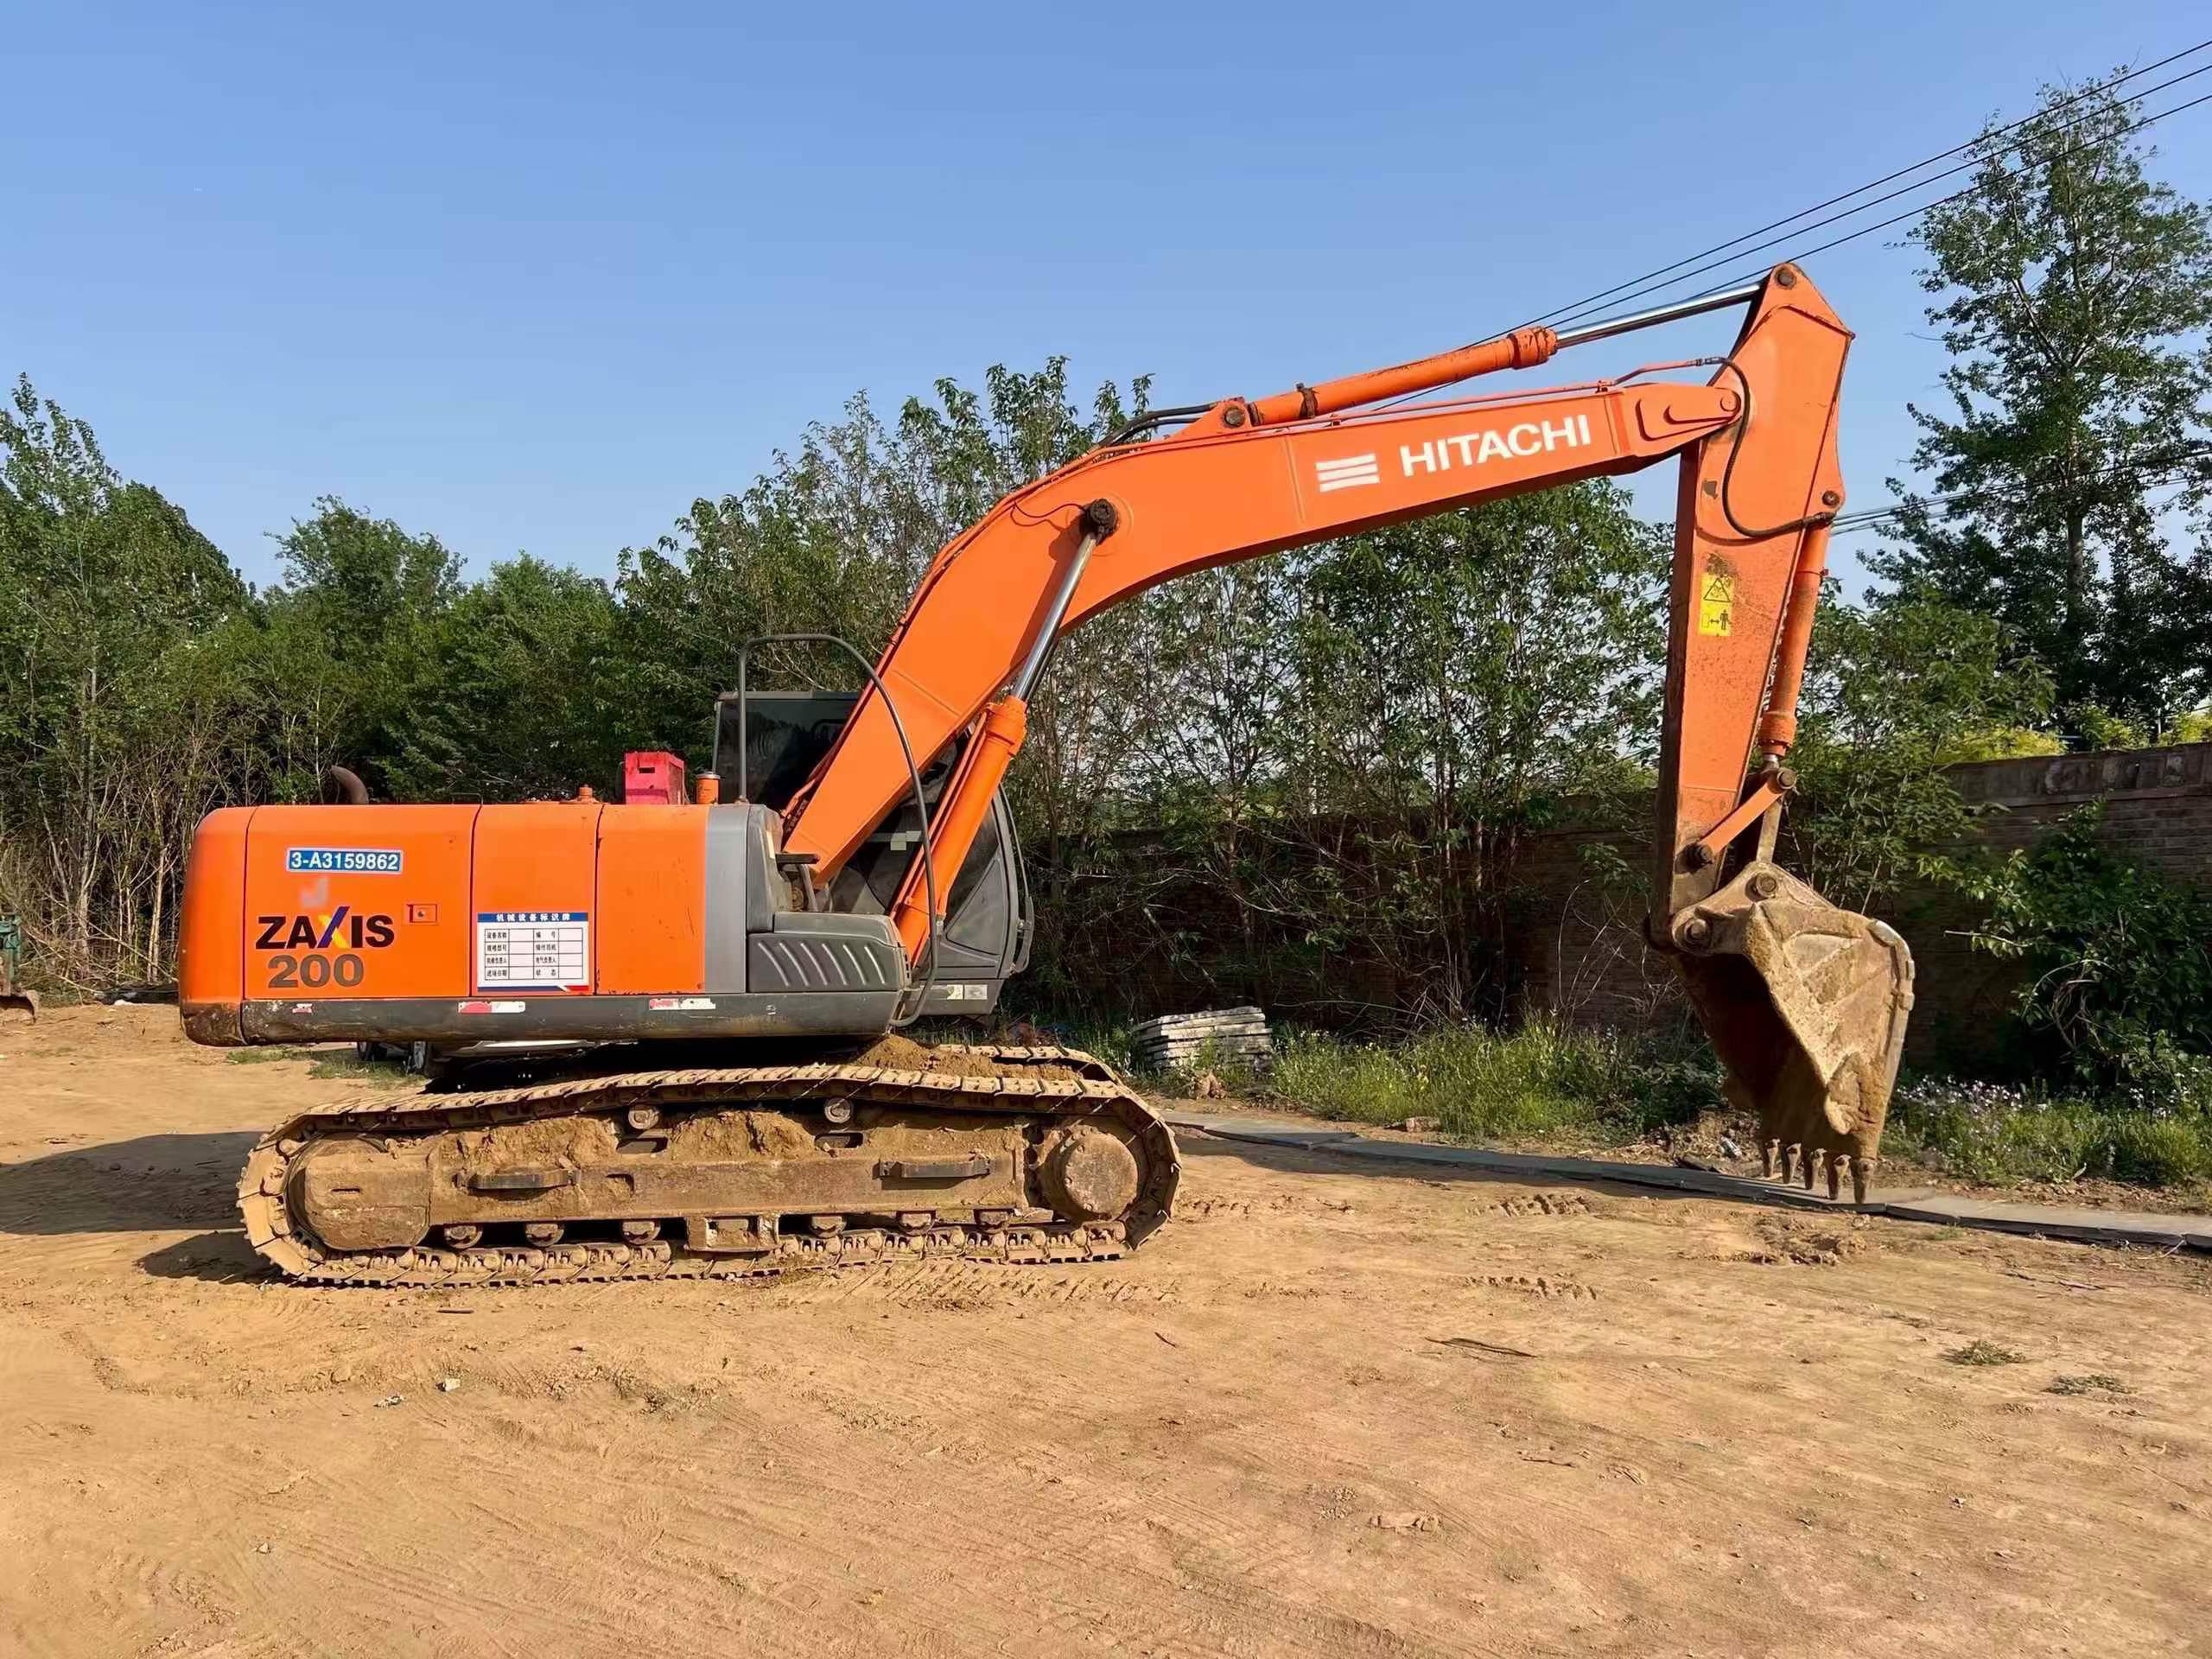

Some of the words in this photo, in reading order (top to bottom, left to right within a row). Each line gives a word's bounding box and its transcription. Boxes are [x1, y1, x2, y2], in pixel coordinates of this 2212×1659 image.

[1400, 414, 1592, 477] HITACHI
[291, 852, 398, 870] 3-A3159862
[255, 906, 395, 950] ZAXIS
[268, 954, 365, 988] 200
